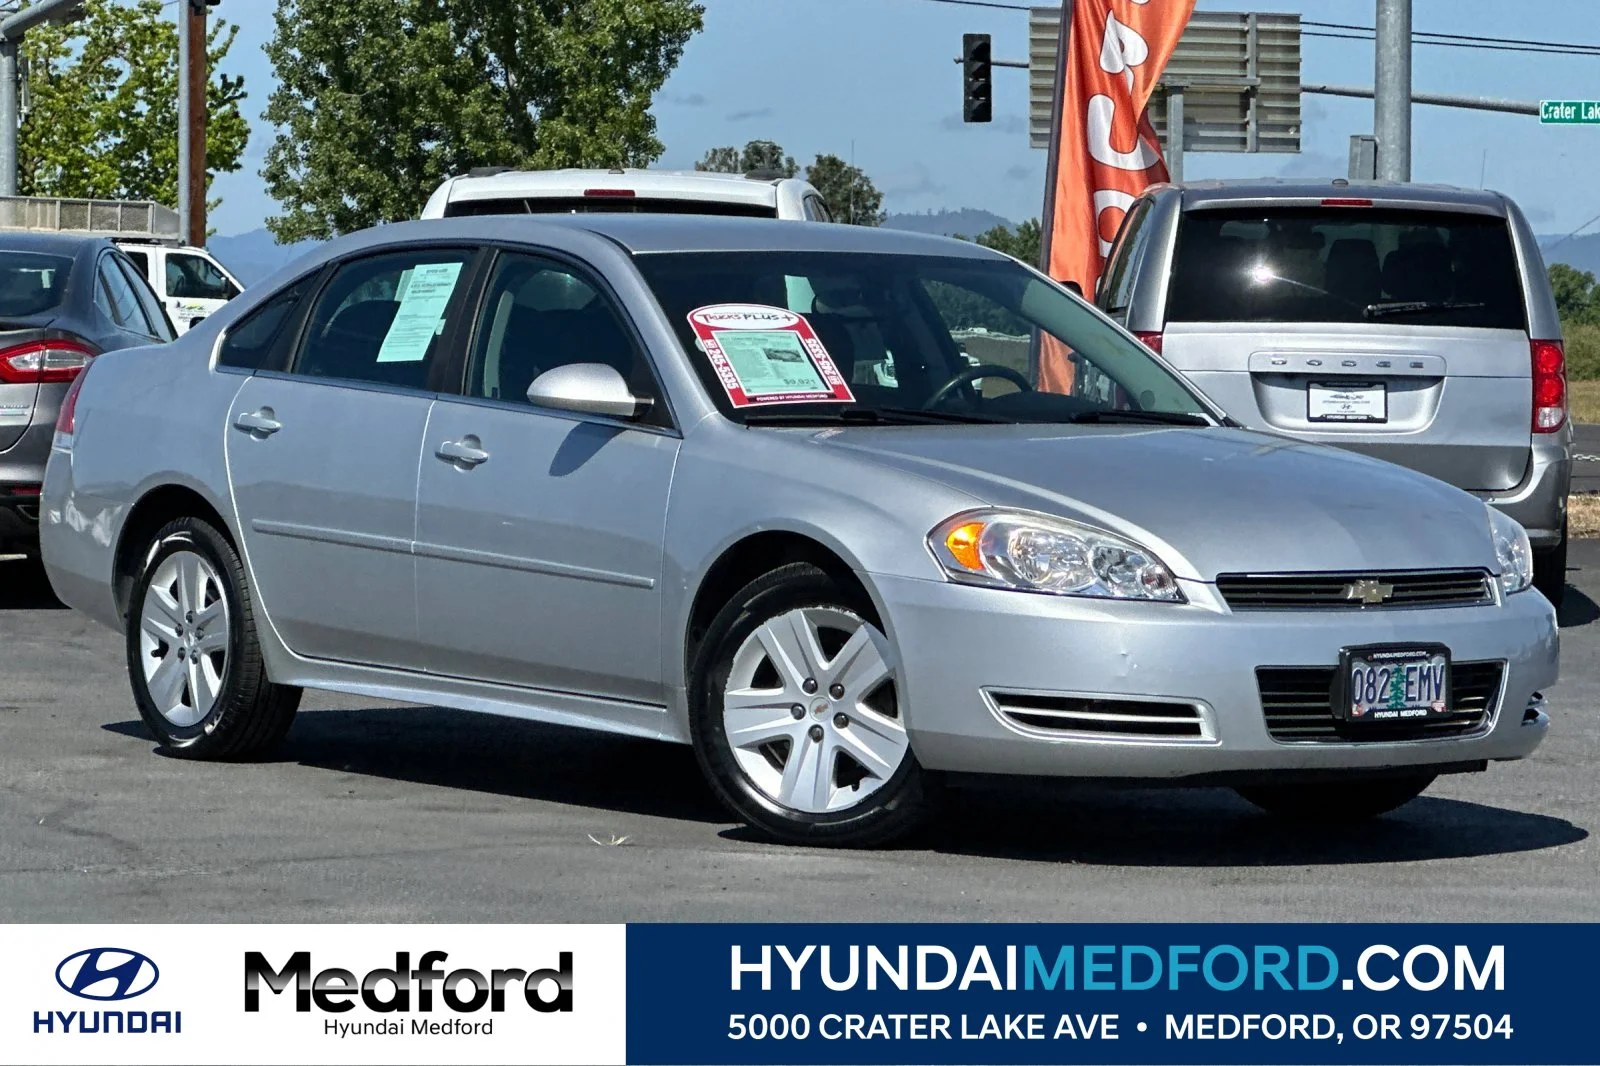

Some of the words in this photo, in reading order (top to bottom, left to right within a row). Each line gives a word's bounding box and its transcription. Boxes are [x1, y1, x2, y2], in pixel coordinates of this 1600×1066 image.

[1541, 102, 1576, 119] Crater
[1353, 667, 1391, 704] 082
[1405, 664, 1445, 702] EMV
[1400, 709, 1427, 717] MEDFORD
